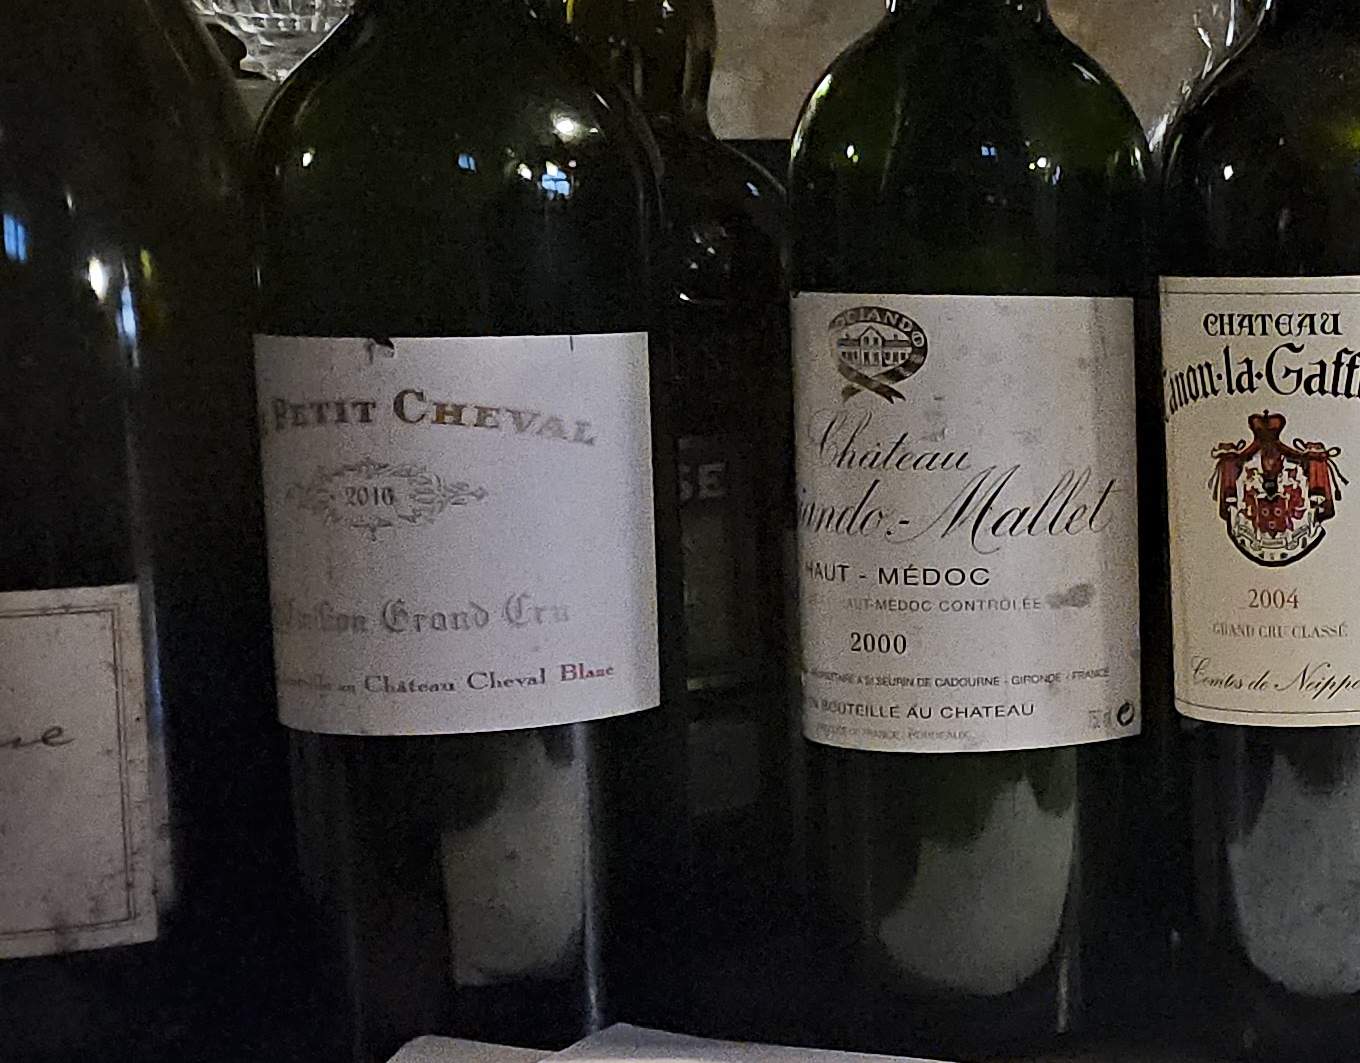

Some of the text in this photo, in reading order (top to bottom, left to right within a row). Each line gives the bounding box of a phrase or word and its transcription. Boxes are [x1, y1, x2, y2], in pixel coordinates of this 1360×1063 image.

[1202, 312, 1343, 337] CHATEAU
[393, 387, 597, 446] CHEVAL
[878, 564, 990, 587] MÉDOC
[1248, 589, 1299, 609] 2004
[383, 597, 489, 635] Grand
[505, 593, 571, 625] Cru
[849, 631, 907, 655] 2000
[467, 667, 546, 690] Cheval
[940, 703, 1035, 720] CHATEAU
